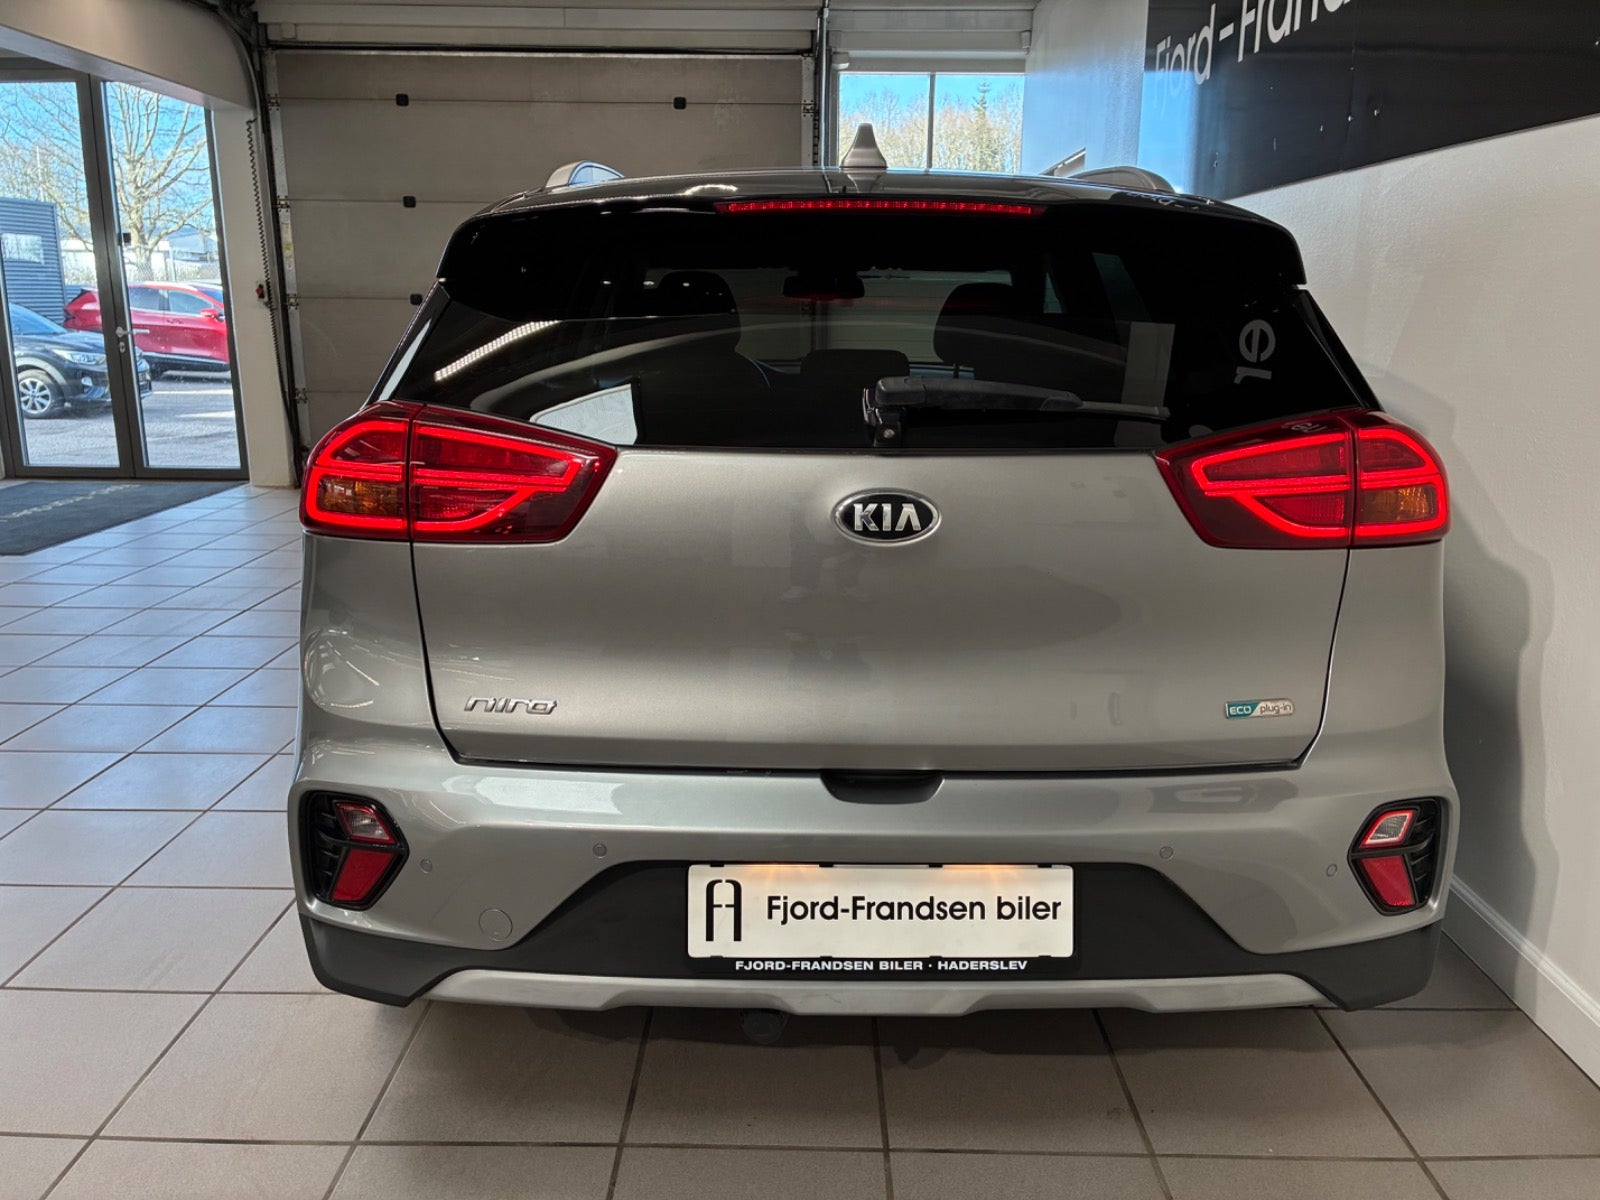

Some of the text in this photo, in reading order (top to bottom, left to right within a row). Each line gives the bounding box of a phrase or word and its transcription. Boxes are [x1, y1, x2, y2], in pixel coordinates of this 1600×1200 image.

[853, 503, 921, 531] KIA
[464, 696, 557, 715] niro
[1229, 703, 1292, 715] ECO plug-in
[767, 895, 986, 926] Fjord-Frandsen
[996, 895, 1062, 921] biler
[735, 960, 1028, 971] FJORD-FRANDSEN BILER HADERSLEV
